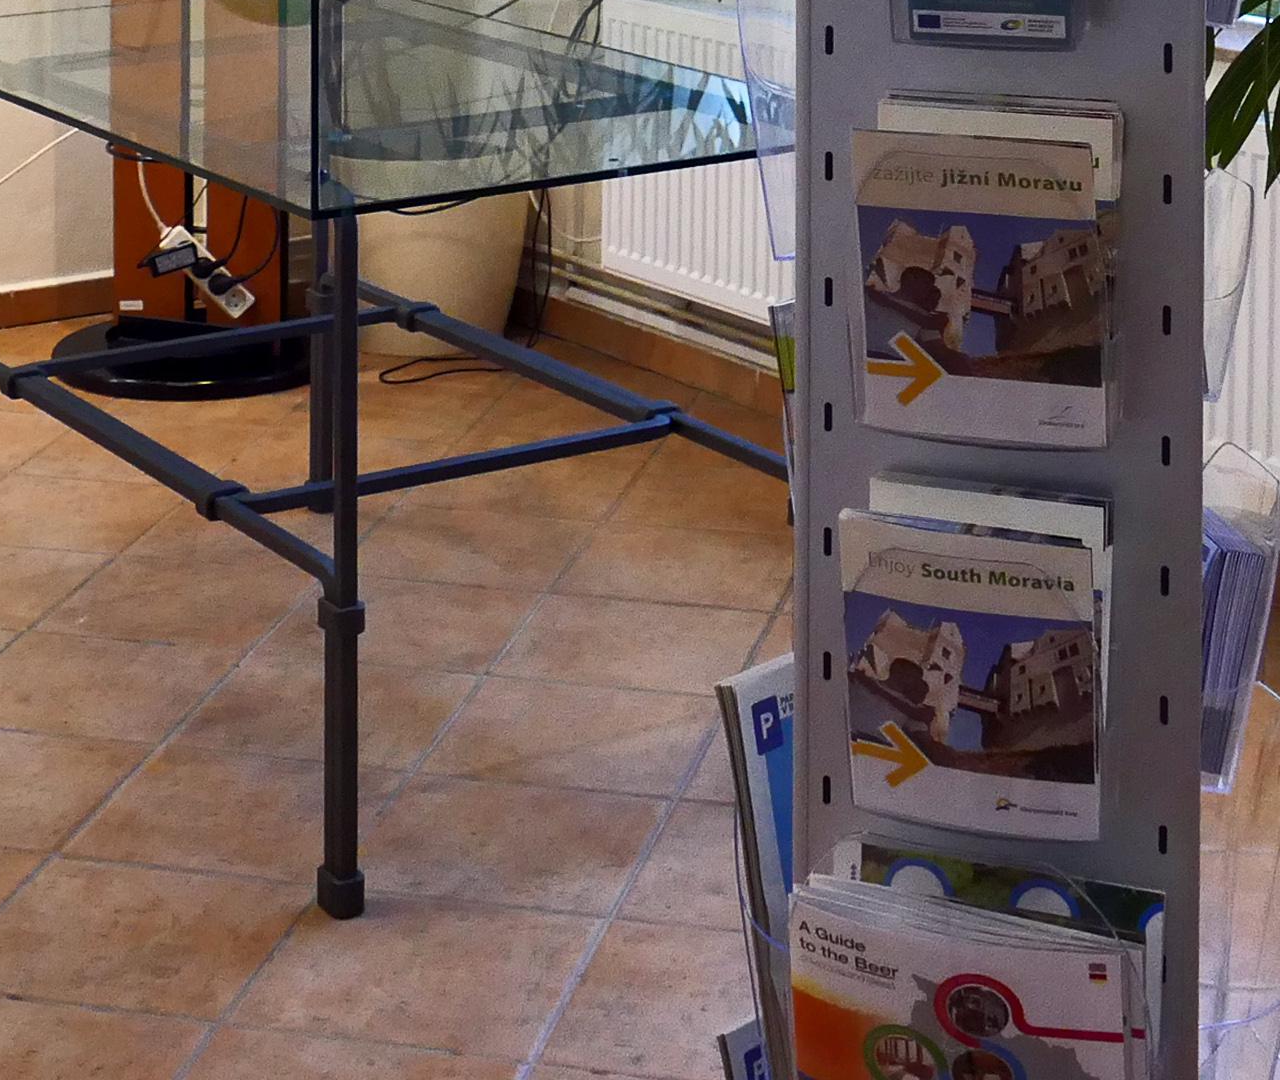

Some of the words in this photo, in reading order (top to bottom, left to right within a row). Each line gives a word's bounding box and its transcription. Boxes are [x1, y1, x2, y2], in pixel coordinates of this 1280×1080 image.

[941, 167, 989, 187] jižní
[998, 171, 1082, 192] Moravu
[869, 551, 914, 578] Enjoy
[921, 563, 982, 584] South
[988, 571, 1075, 592] Moravia
[799, 920, 811, 935] A
[815, 927, 866, 952] Guide
[799, 937, 816, 953] to
[821, 945, 849, 964] the
[854, 956, 899, 978] Beer
